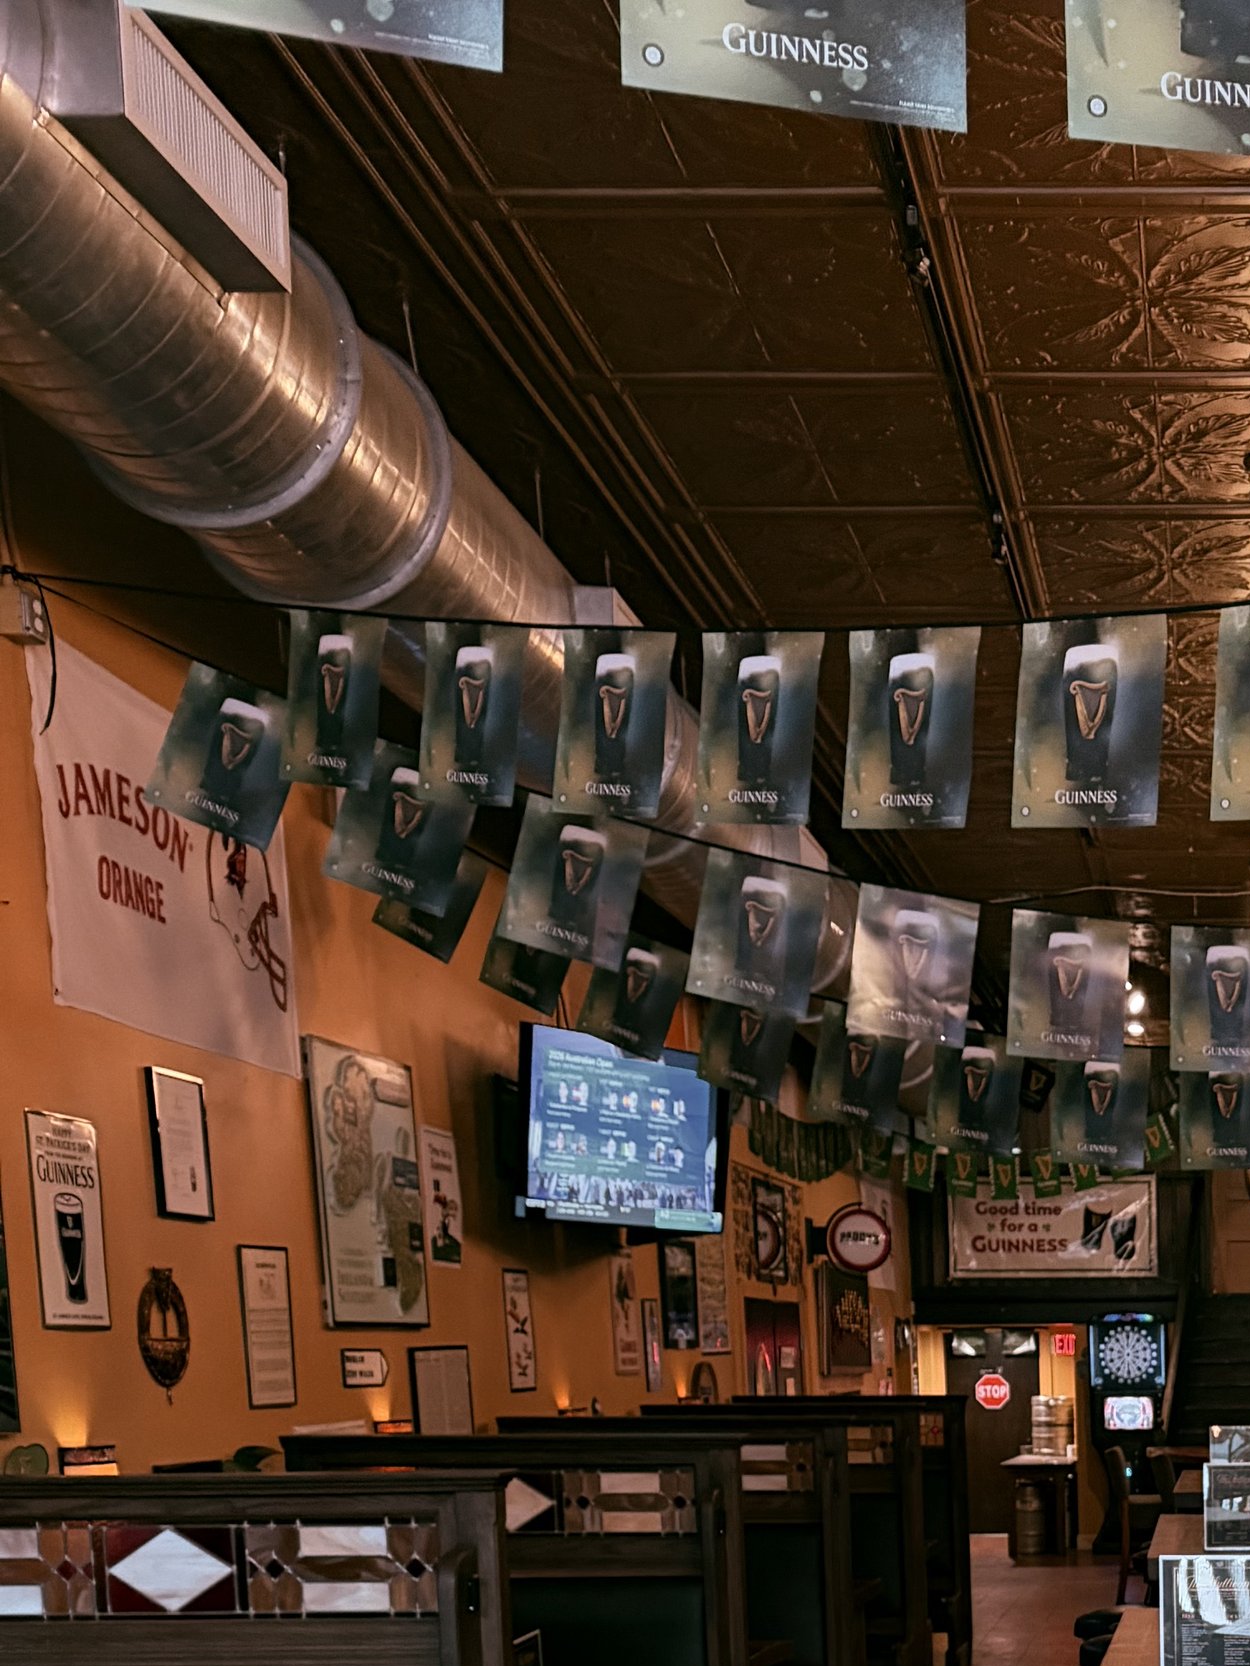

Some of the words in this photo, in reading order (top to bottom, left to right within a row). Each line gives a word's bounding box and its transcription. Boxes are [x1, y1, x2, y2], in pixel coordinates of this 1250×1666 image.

[722, 22, 869, 71] GUINNESS
[306, 753, 348, 770] GUINNESS
[445, 769, 490, 786] GUINNESS
[585, 781, 631, 798] GUINNESS
[729, 789, 779, 804] GUINNESS
[1054, 789, 1118, 806] GUINNESS
[184, 790, 240, 823] GUINNESS
[880, 793, 934, 807] GUINNESS
[55, 762, 189, 874] JAMESON
[361, 861, 415, 890] GUINNESS
[97, 853, 168, 926] ORANGE
[535, 920, 589, 947] GUINNESS
[723, 974, 776, 997] GUINNESS
[1041, 1031, 1091, 1047] GUINNESS
[596, 1057, 614, 1068] Open
[1077, 1142, 1118, 1154] GUINNESS
[1206, 1146, 1247, 1157] GUINNESS
[36, 1154, 95, 1189] GUINNESS
[975, 1201, 1020, 1217] Good
[1024, 1201, 1062, 1217] time
[1000, 1217, 1023, 1233] for
[1028, 1222, 1038, 1233] a
[970, 1235, 1068, 1253] GUINNESS
[1054, 1333, 1076, 1356] EXIT
[977, 1385, 1006, 1399] STOP
